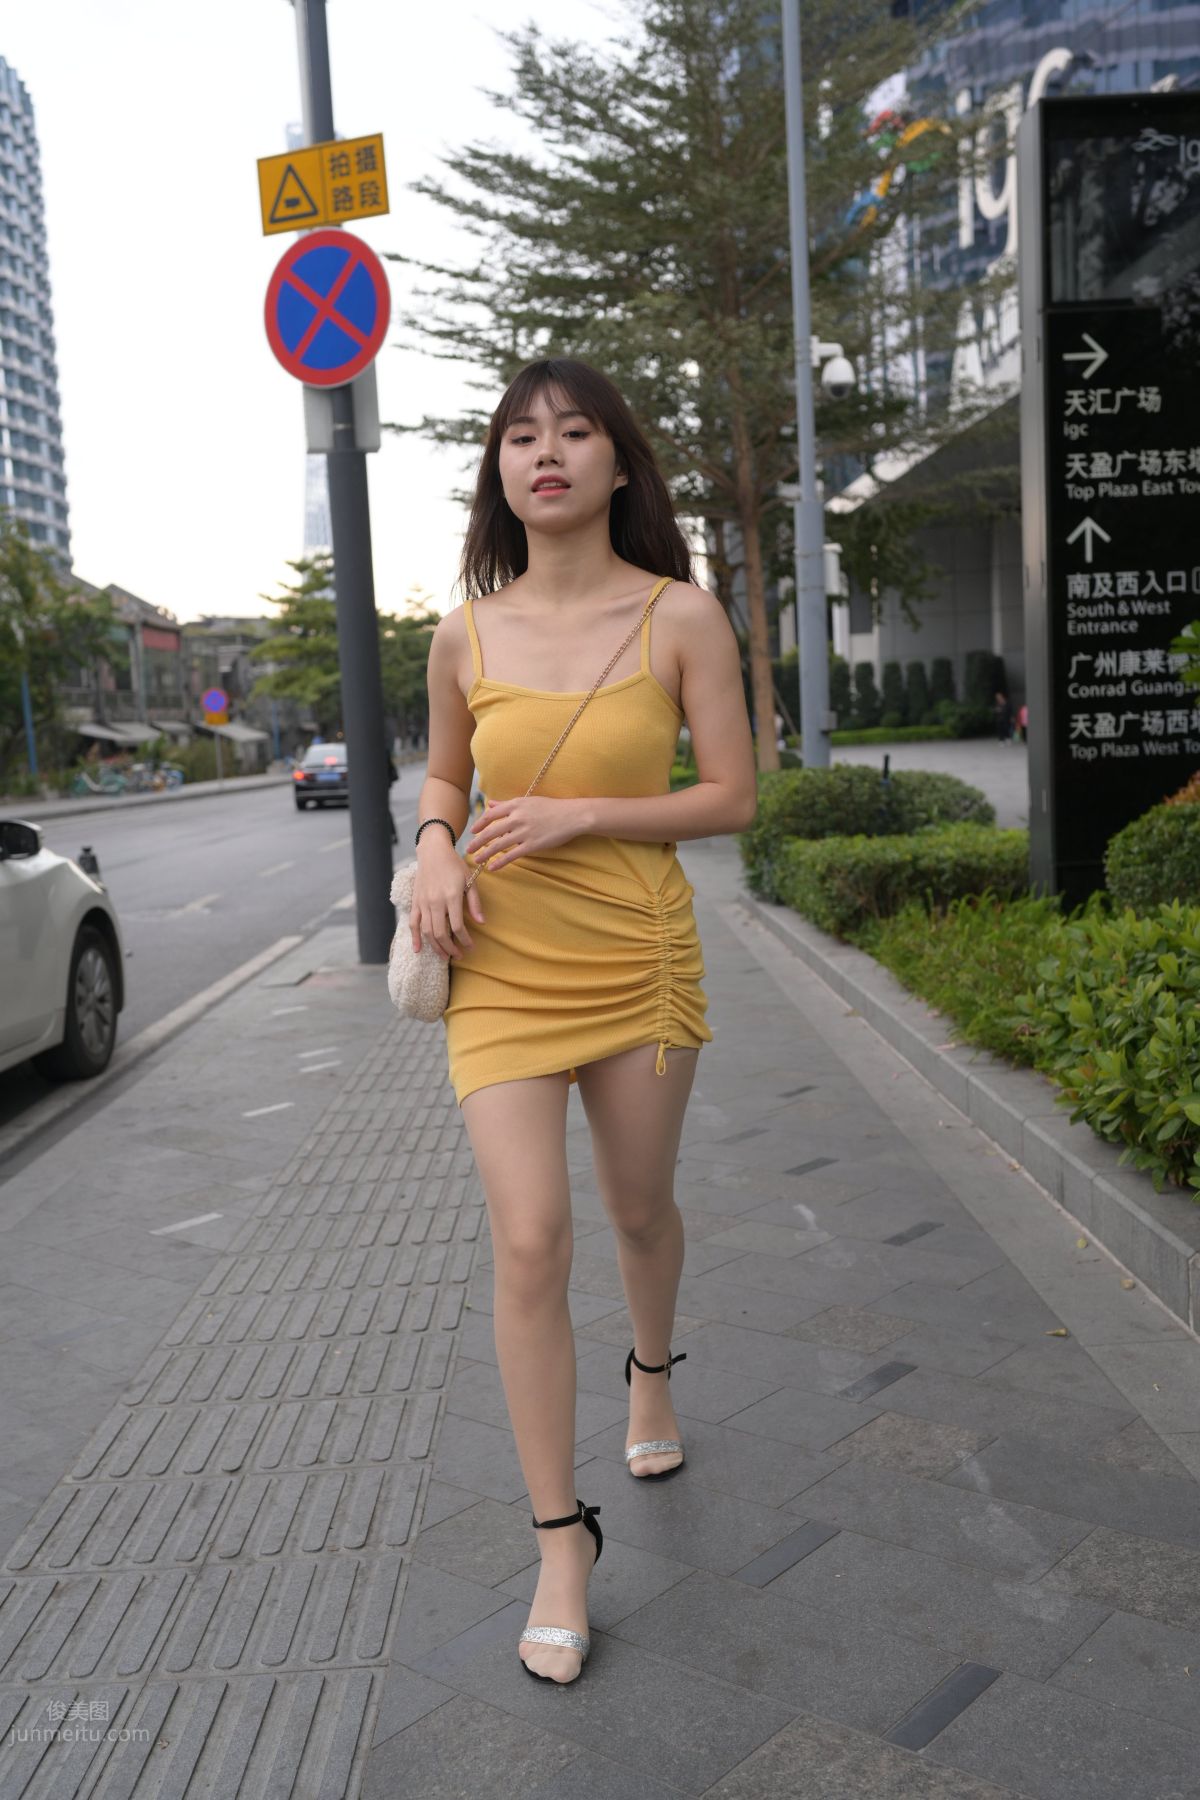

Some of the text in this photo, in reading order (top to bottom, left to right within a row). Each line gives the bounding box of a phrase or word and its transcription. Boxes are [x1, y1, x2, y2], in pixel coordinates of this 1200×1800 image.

[329, 144, 377, 179] 拍摄
[332, 180, 381, 213] 路段
[1064, 386, 1161, 416] 天汇广场
[1063, 421, 1089, 440] igc
[1065, 484, 1095, 500] Top
[1098, 481, 1138, 497] Plaza
[1142, 480, 1174, 496] East
[1066, 570, 1186, 599] 南及西入口
[1067, 600, 1171, 618] South & West
[1067, 620, 1138, 635] Entrance
[1068, 679, 1200, 698] Conrad Guang
[1070, 744, 1097, 761] Top
[1101, 742, 1139, 757] Plaza
[1142, 740, 1179, 756] West
